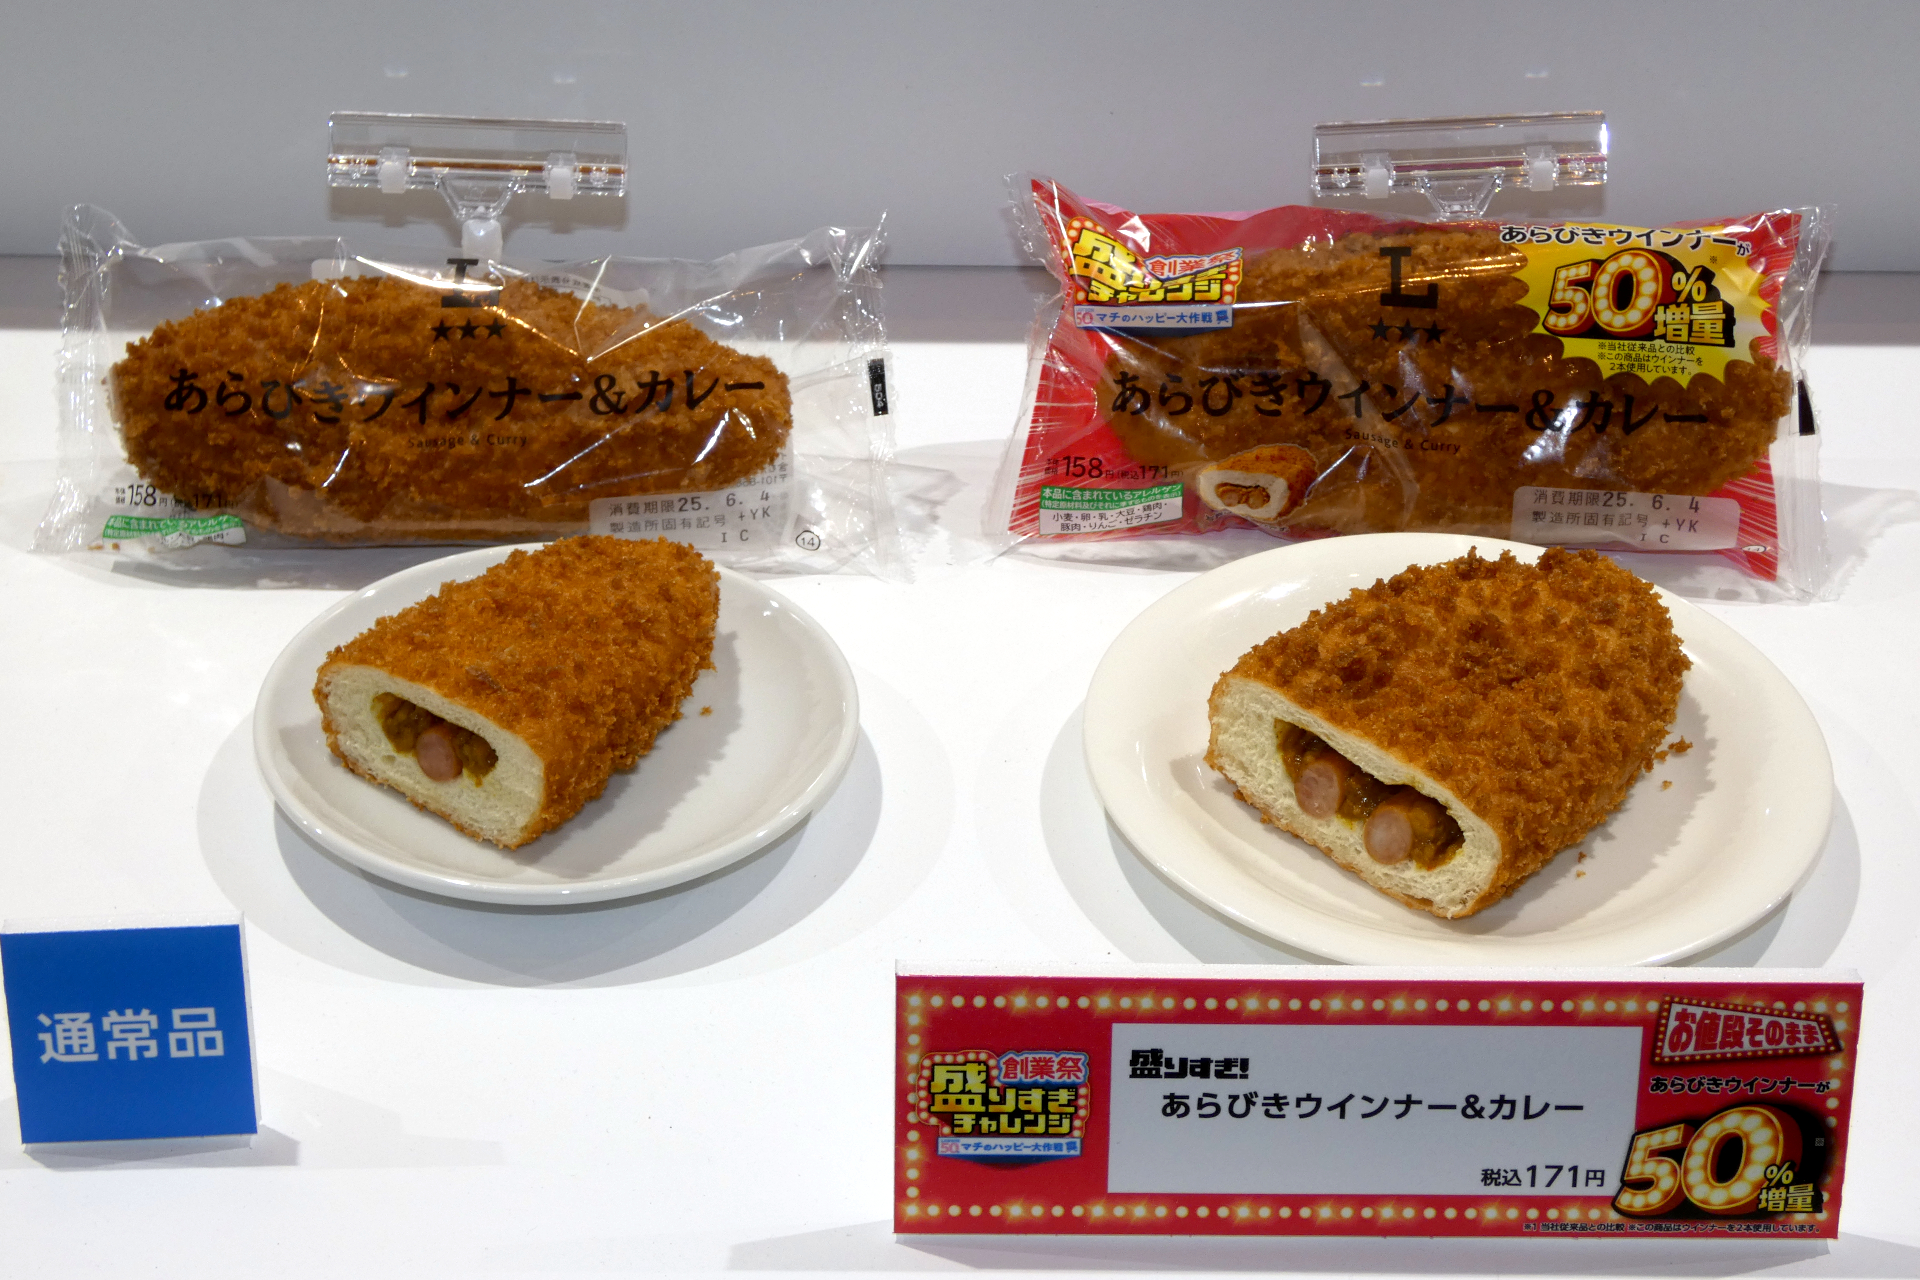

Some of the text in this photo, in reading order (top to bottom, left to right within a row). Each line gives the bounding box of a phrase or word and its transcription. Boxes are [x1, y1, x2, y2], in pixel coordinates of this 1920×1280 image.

[1500, 225, 1752, 257] あらびきウインナーが
[1380, 246, 1439, 309] L
[1654, 301, 1726, 345] 増量
[1610, 362, 1693, 376] 2本使用しています。
[1112, 370, 1708, 435] あらびきウインナー&カレー
[408, 433, 528, 450] Sausage & Curry
[1345, 427, 1460, 455] Sausage & Curry
[1043, 485, 1182, 501] 本品に含まれているアレルゲン
[610, 514, 726, 533] 製造所固有記号
[1532, 511, 1649, 528] 製造所固有記号
[36, 1007, 225, 1064] 通常品
[1667, 1007, 1821, 1054] お値段そのまま
[1002, 1056, 1084, 1081] 創業祭
[1129, 1048, 1250, 1079] 盛りすぎ!
[929, 1062, 1076, 1114] 盛りすぎ
[1649, 1075, 1831, 1095] あらびきウインナーが
[1161, 1090, 1584, 1121] あらびきウインナー&カレー
[953, 1113, 1072, 1134] チャレンジ
[1758, 1183, 1815, 1212] 増量
